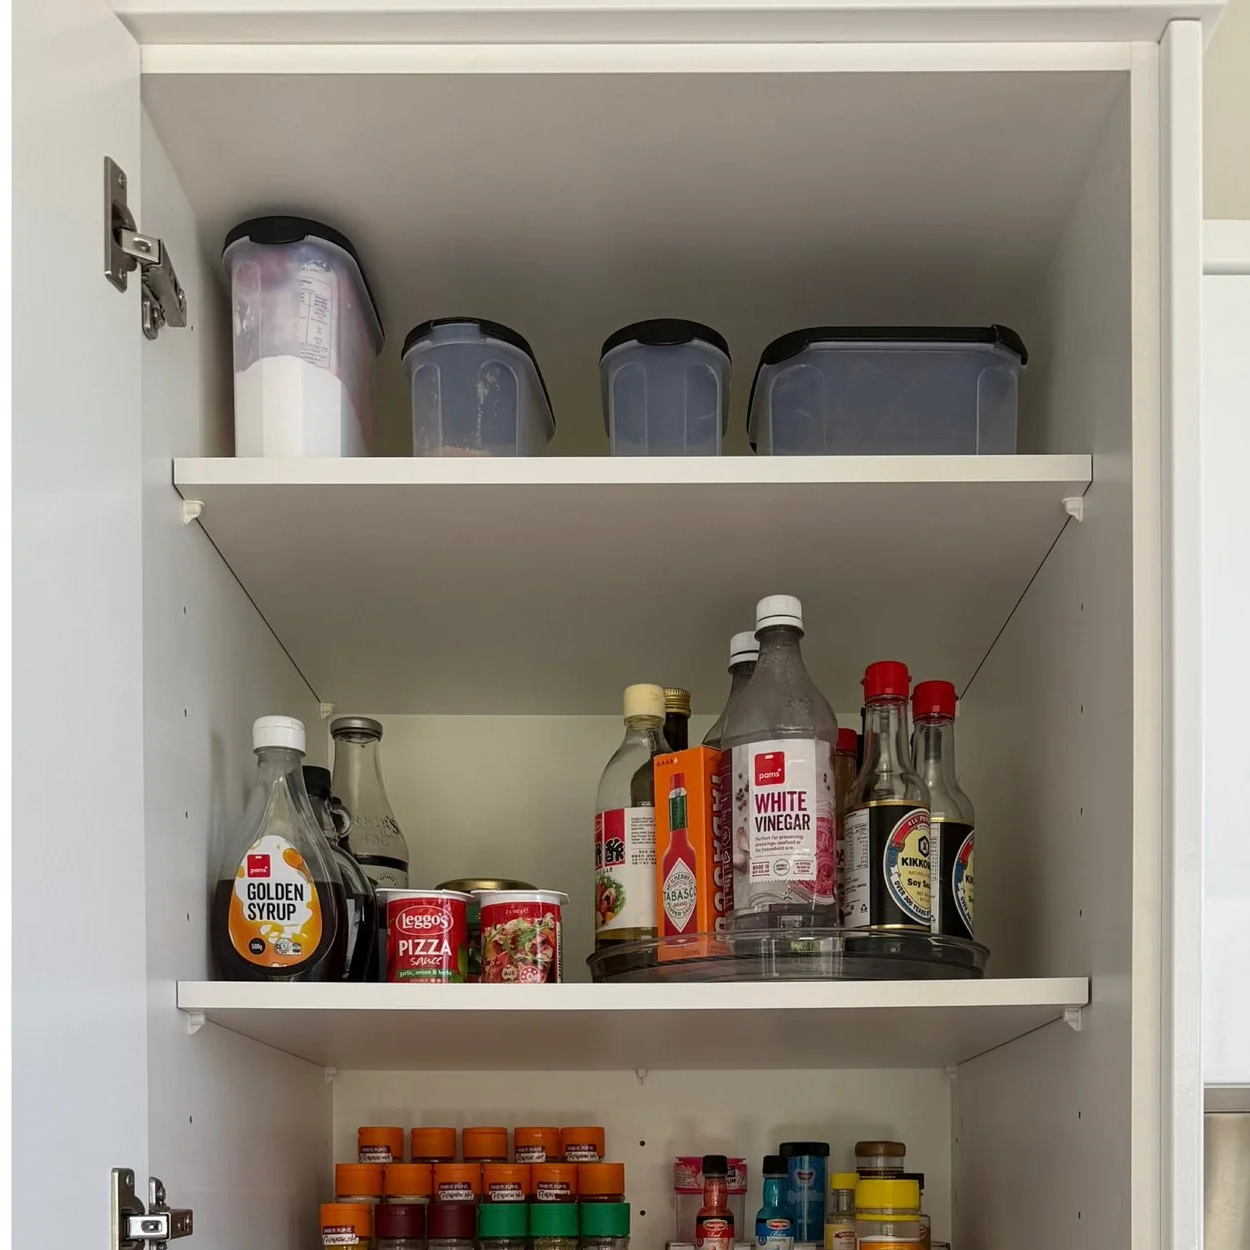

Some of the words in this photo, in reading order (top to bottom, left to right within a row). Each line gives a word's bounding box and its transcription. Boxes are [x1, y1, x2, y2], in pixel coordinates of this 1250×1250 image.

[758, 770, 780, 781] pams
[755, 790, 807, 814] WHITE
[755, 813, 811, 833] VINEGAR
[779, 835, 804, 843] preserving,
[250, 866, 267, 874] pams
[894, 880, 906, 896] OVER
[907, 878, 921, 888] Soy
[247, 883, 304, 901] GOLDEN
[663, 886, 697, 901] TABASCO
[247, 903, 296, 921] SYRUP
[402, 912, 449, 931] Leggo's
[399, 939, 452, 956] PIZZA
[410, 955, 443, 966] sauce
